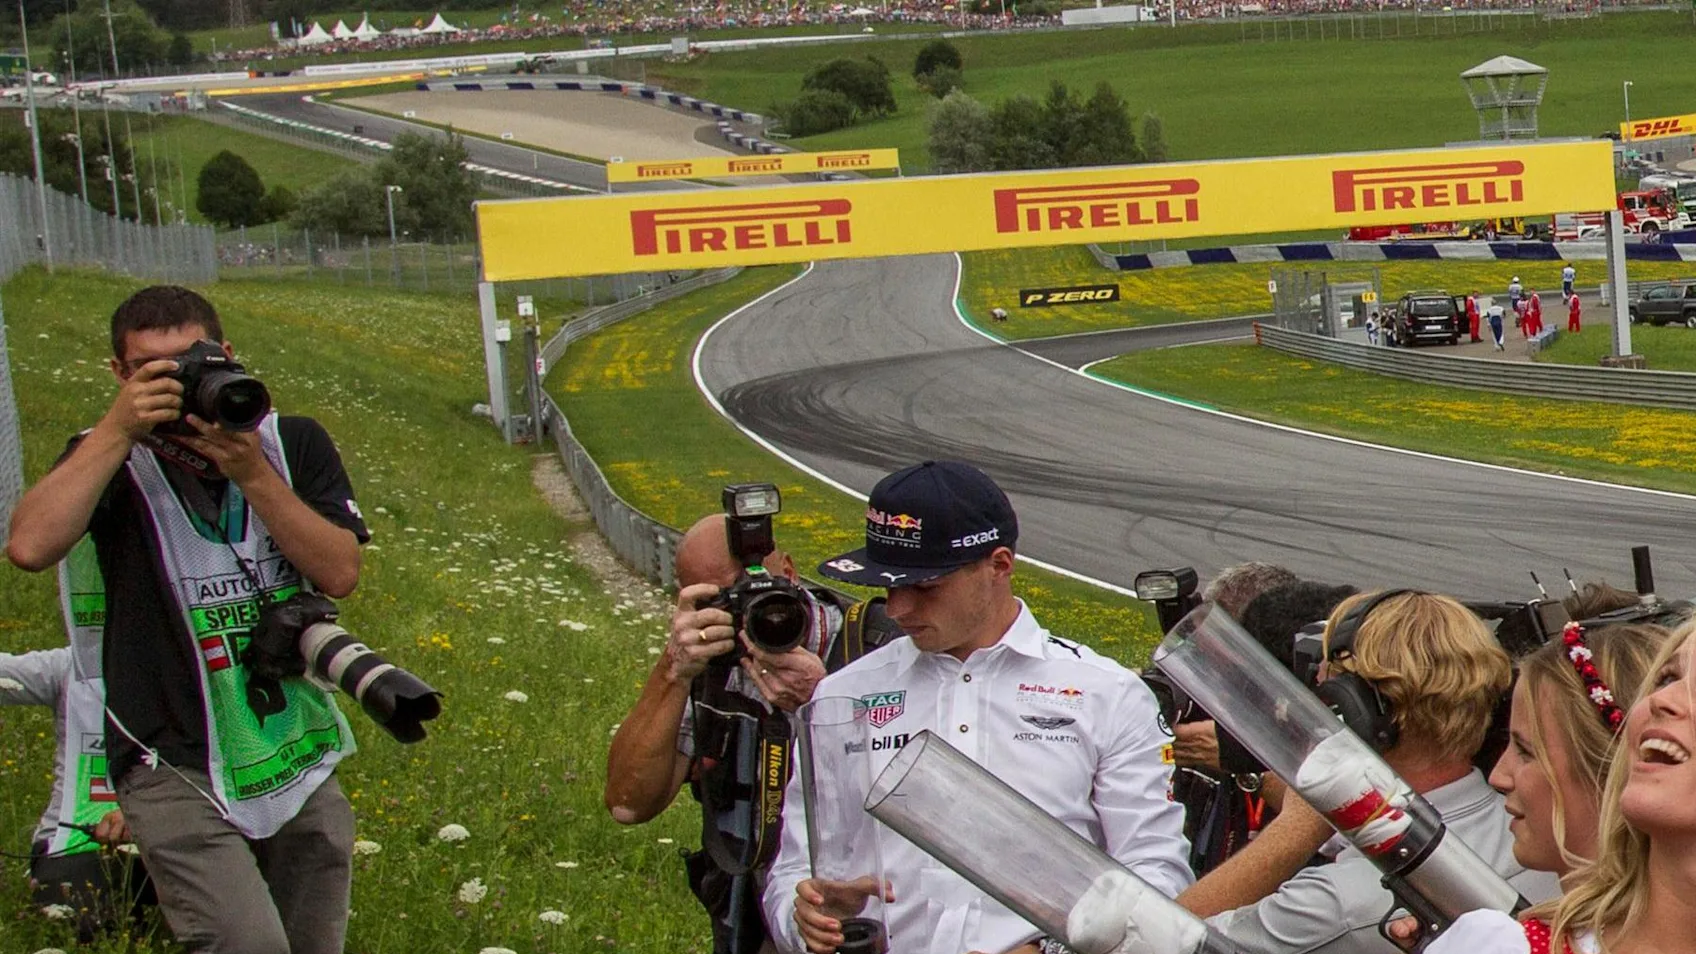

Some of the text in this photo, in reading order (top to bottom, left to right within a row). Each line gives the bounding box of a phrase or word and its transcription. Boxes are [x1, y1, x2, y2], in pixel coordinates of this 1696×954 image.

[1634, 119, 1682, 138] DHL
[728, 158, 782, 172] PIRELLI
[817, 154, 870, 168] PIRELLI
[638, 163, 692, 176] PIRELLI
[1332, 160, 1525, 213] PIRELLI
[994, 178, 1200, 233] PIRELLI
[630, 199, 852, 256] PIRELLI
[1025, 289, 1114, 304] P ZERO
[867, 523, 922, 540] ACING
[963, 527, 1000, 547] exact
[1018, 683, 1056, 694] Red Bull
[864, 694, 900, 707] TAG
[1013, 732, 1080, 744] ASTON MARTIN
[770, 744, 782, 787] Nikon
